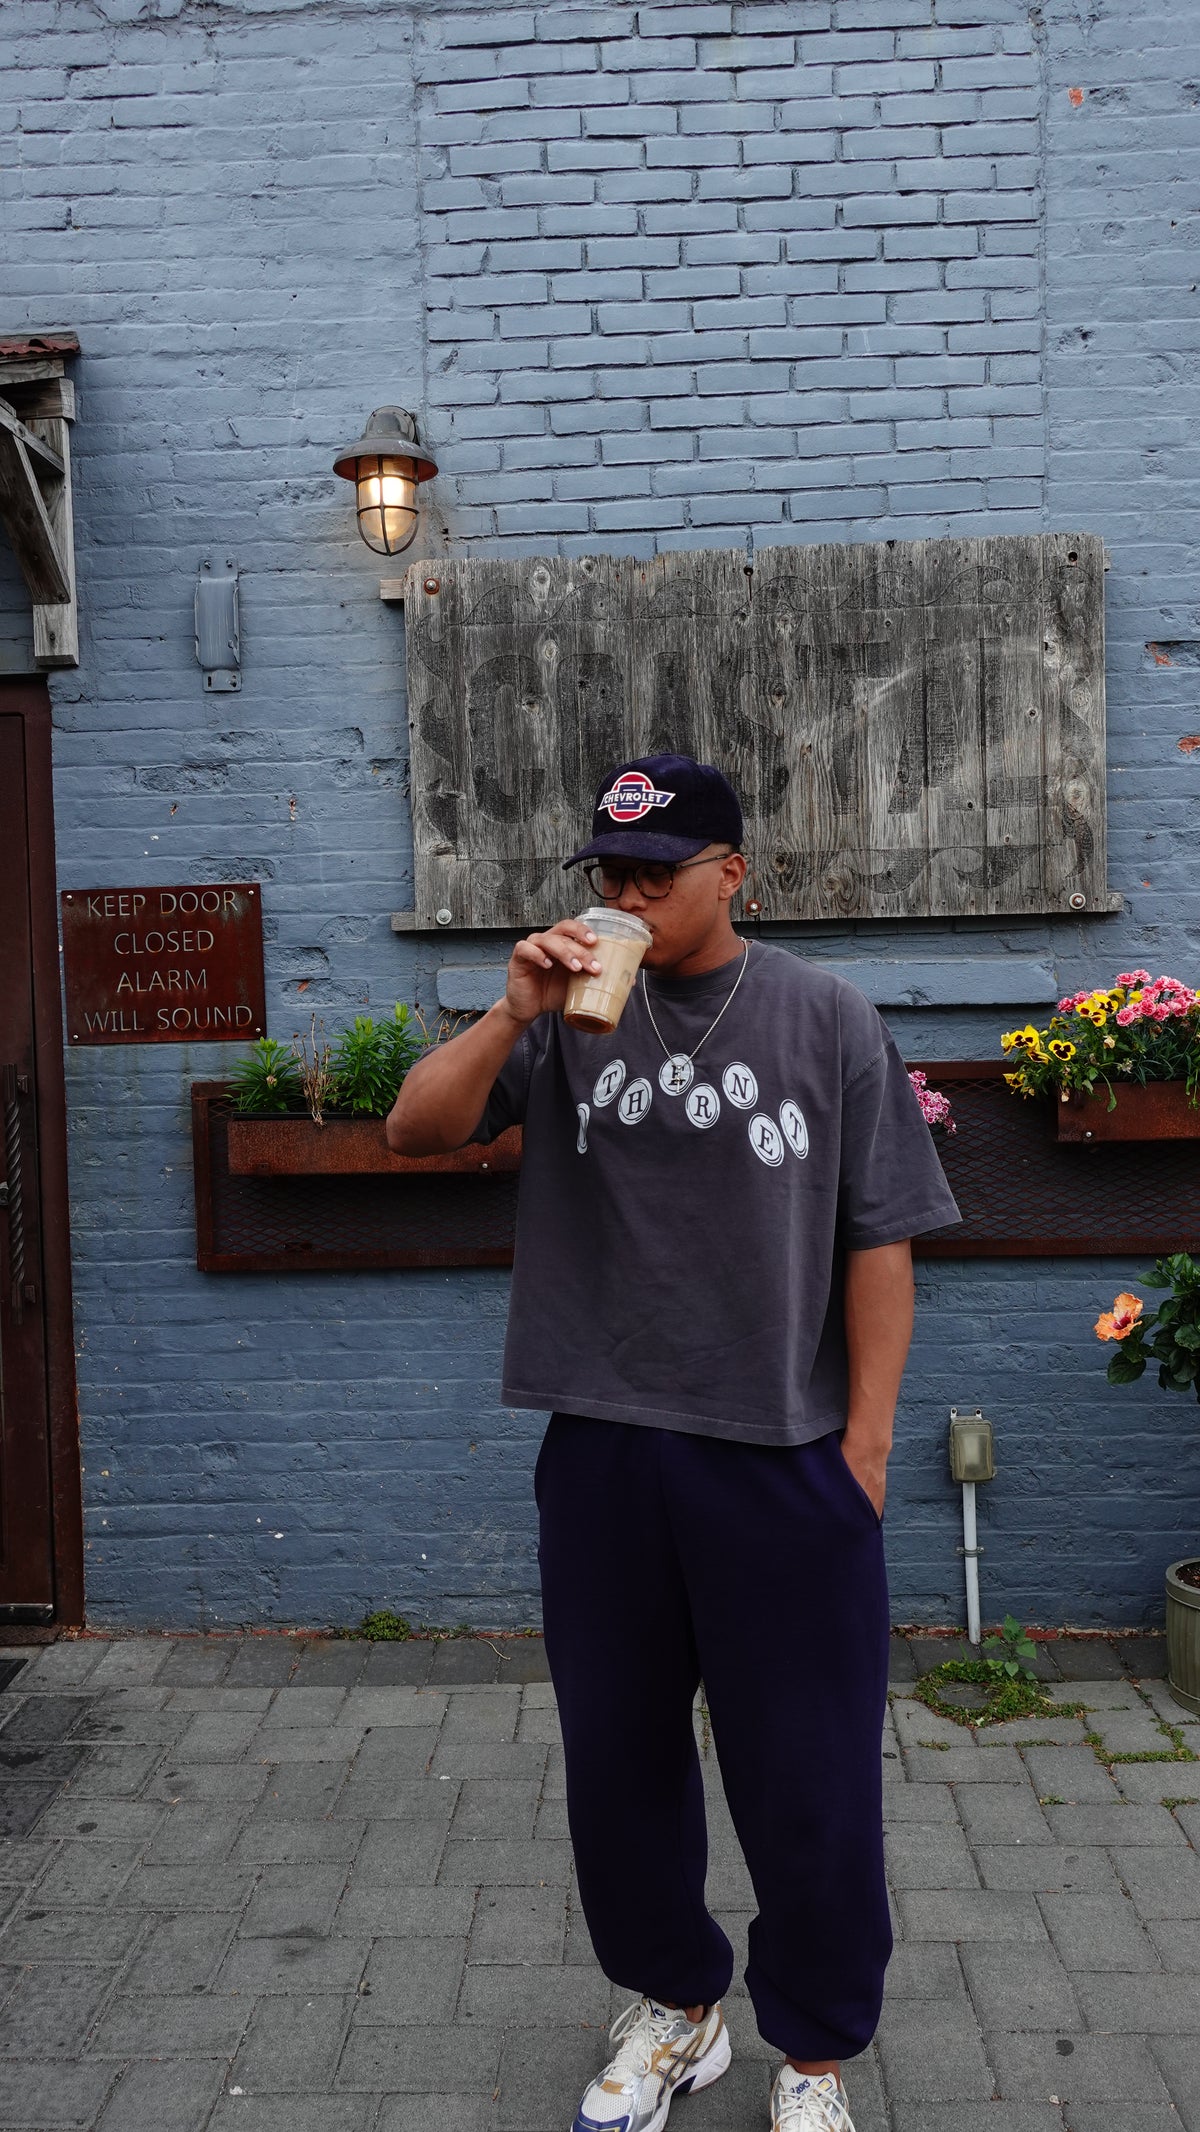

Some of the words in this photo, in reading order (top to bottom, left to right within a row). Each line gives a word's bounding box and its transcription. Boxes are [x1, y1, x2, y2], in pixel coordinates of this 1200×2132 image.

[604, 792, 664, 804] CHEVROLET
[87, 894, 146, 918] KEEP
[160, 890, 238, 915] DOOR
[114, 930, 214, 955] CLOSED
[116, 968, 207, 993] ALARM
[84, 1009, 144, 1033] WILL
[157, 1005, 252, 1030] SOUND
[578, 1058, 806, 1161] THERNET
